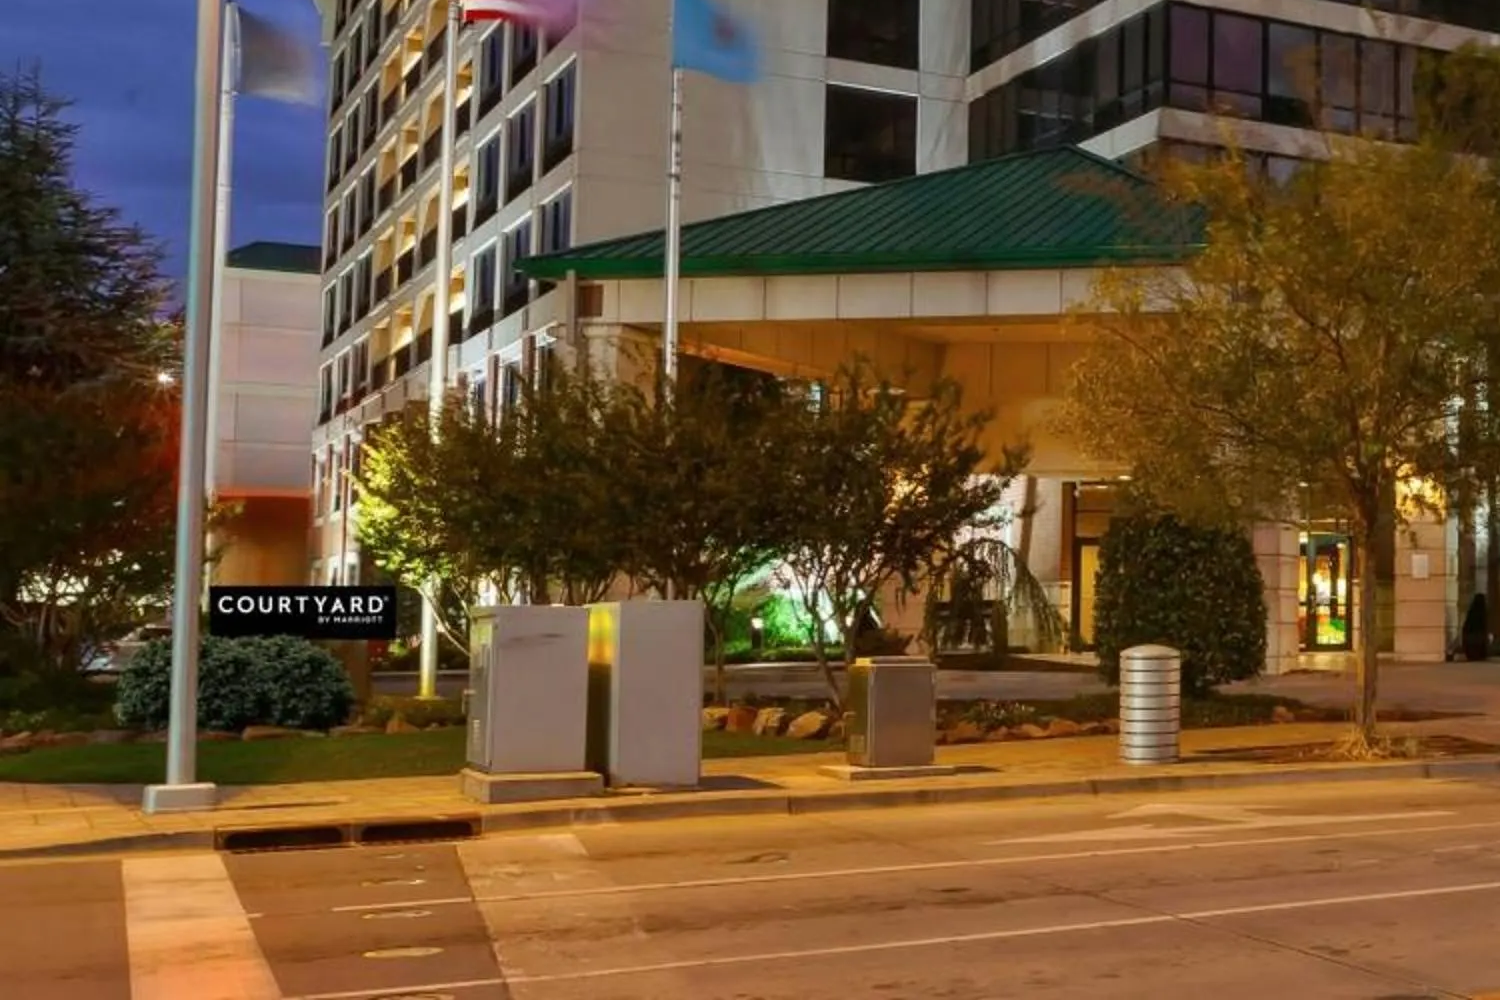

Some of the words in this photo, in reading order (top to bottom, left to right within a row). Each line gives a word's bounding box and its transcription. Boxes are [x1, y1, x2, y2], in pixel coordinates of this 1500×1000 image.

[217, 595, 384, 614] COURTYARD
[317, 615, 330, 624] BY
[333, 615, 383, 624] MARRIOTT
